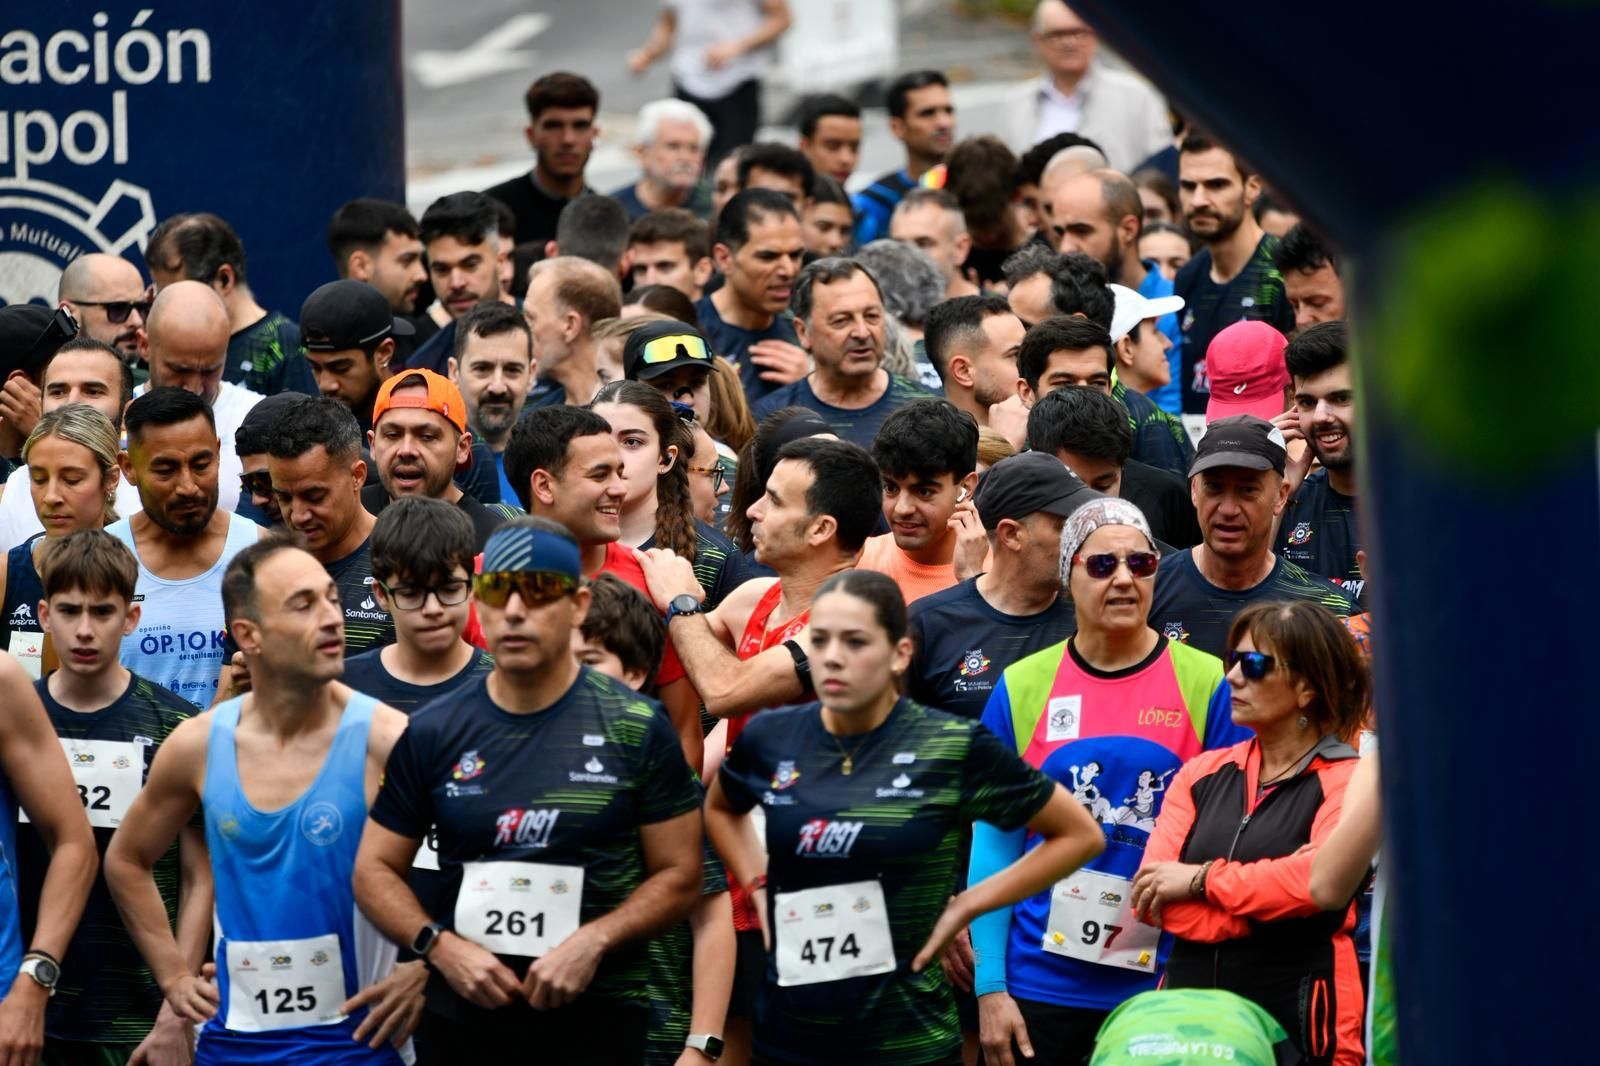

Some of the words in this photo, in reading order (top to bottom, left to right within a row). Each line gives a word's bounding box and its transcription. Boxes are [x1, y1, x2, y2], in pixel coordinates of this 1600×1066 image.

[345, 608, 387, 620] Santander
[1138, 705, 1183, 727] LÓPEZ
[569, 771, 618, 783] Santander
[485, 910, 545, 937] 261
[1081, 920, 1123, 948] 97
[801, 933, 861, 965] 474
[255, 986, 317, 1014] 125
